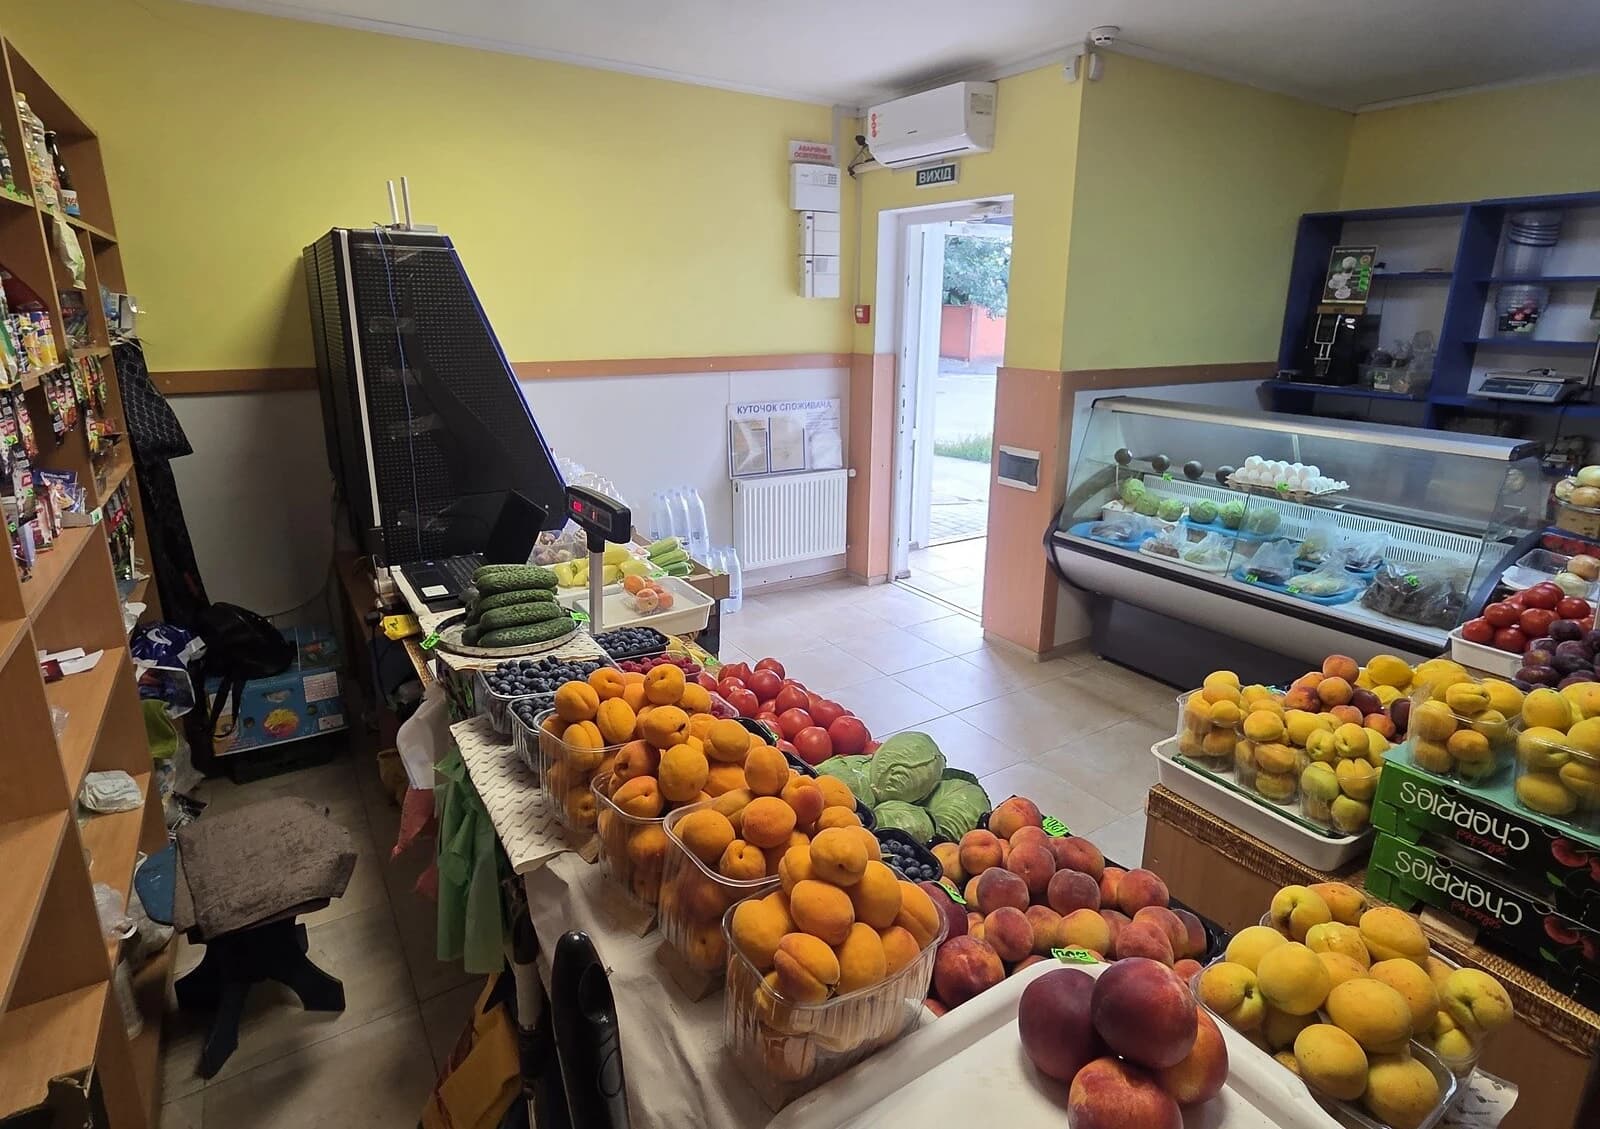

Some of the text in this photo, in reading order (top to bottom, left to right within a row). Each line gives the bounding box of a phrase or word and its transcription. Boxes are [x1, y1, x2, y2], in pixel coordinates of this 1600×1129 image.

[918, 167, 953, 184] ВИХІД
[737, 400, 832, 414] КУТОЧОК СПОЖИВАЧА
